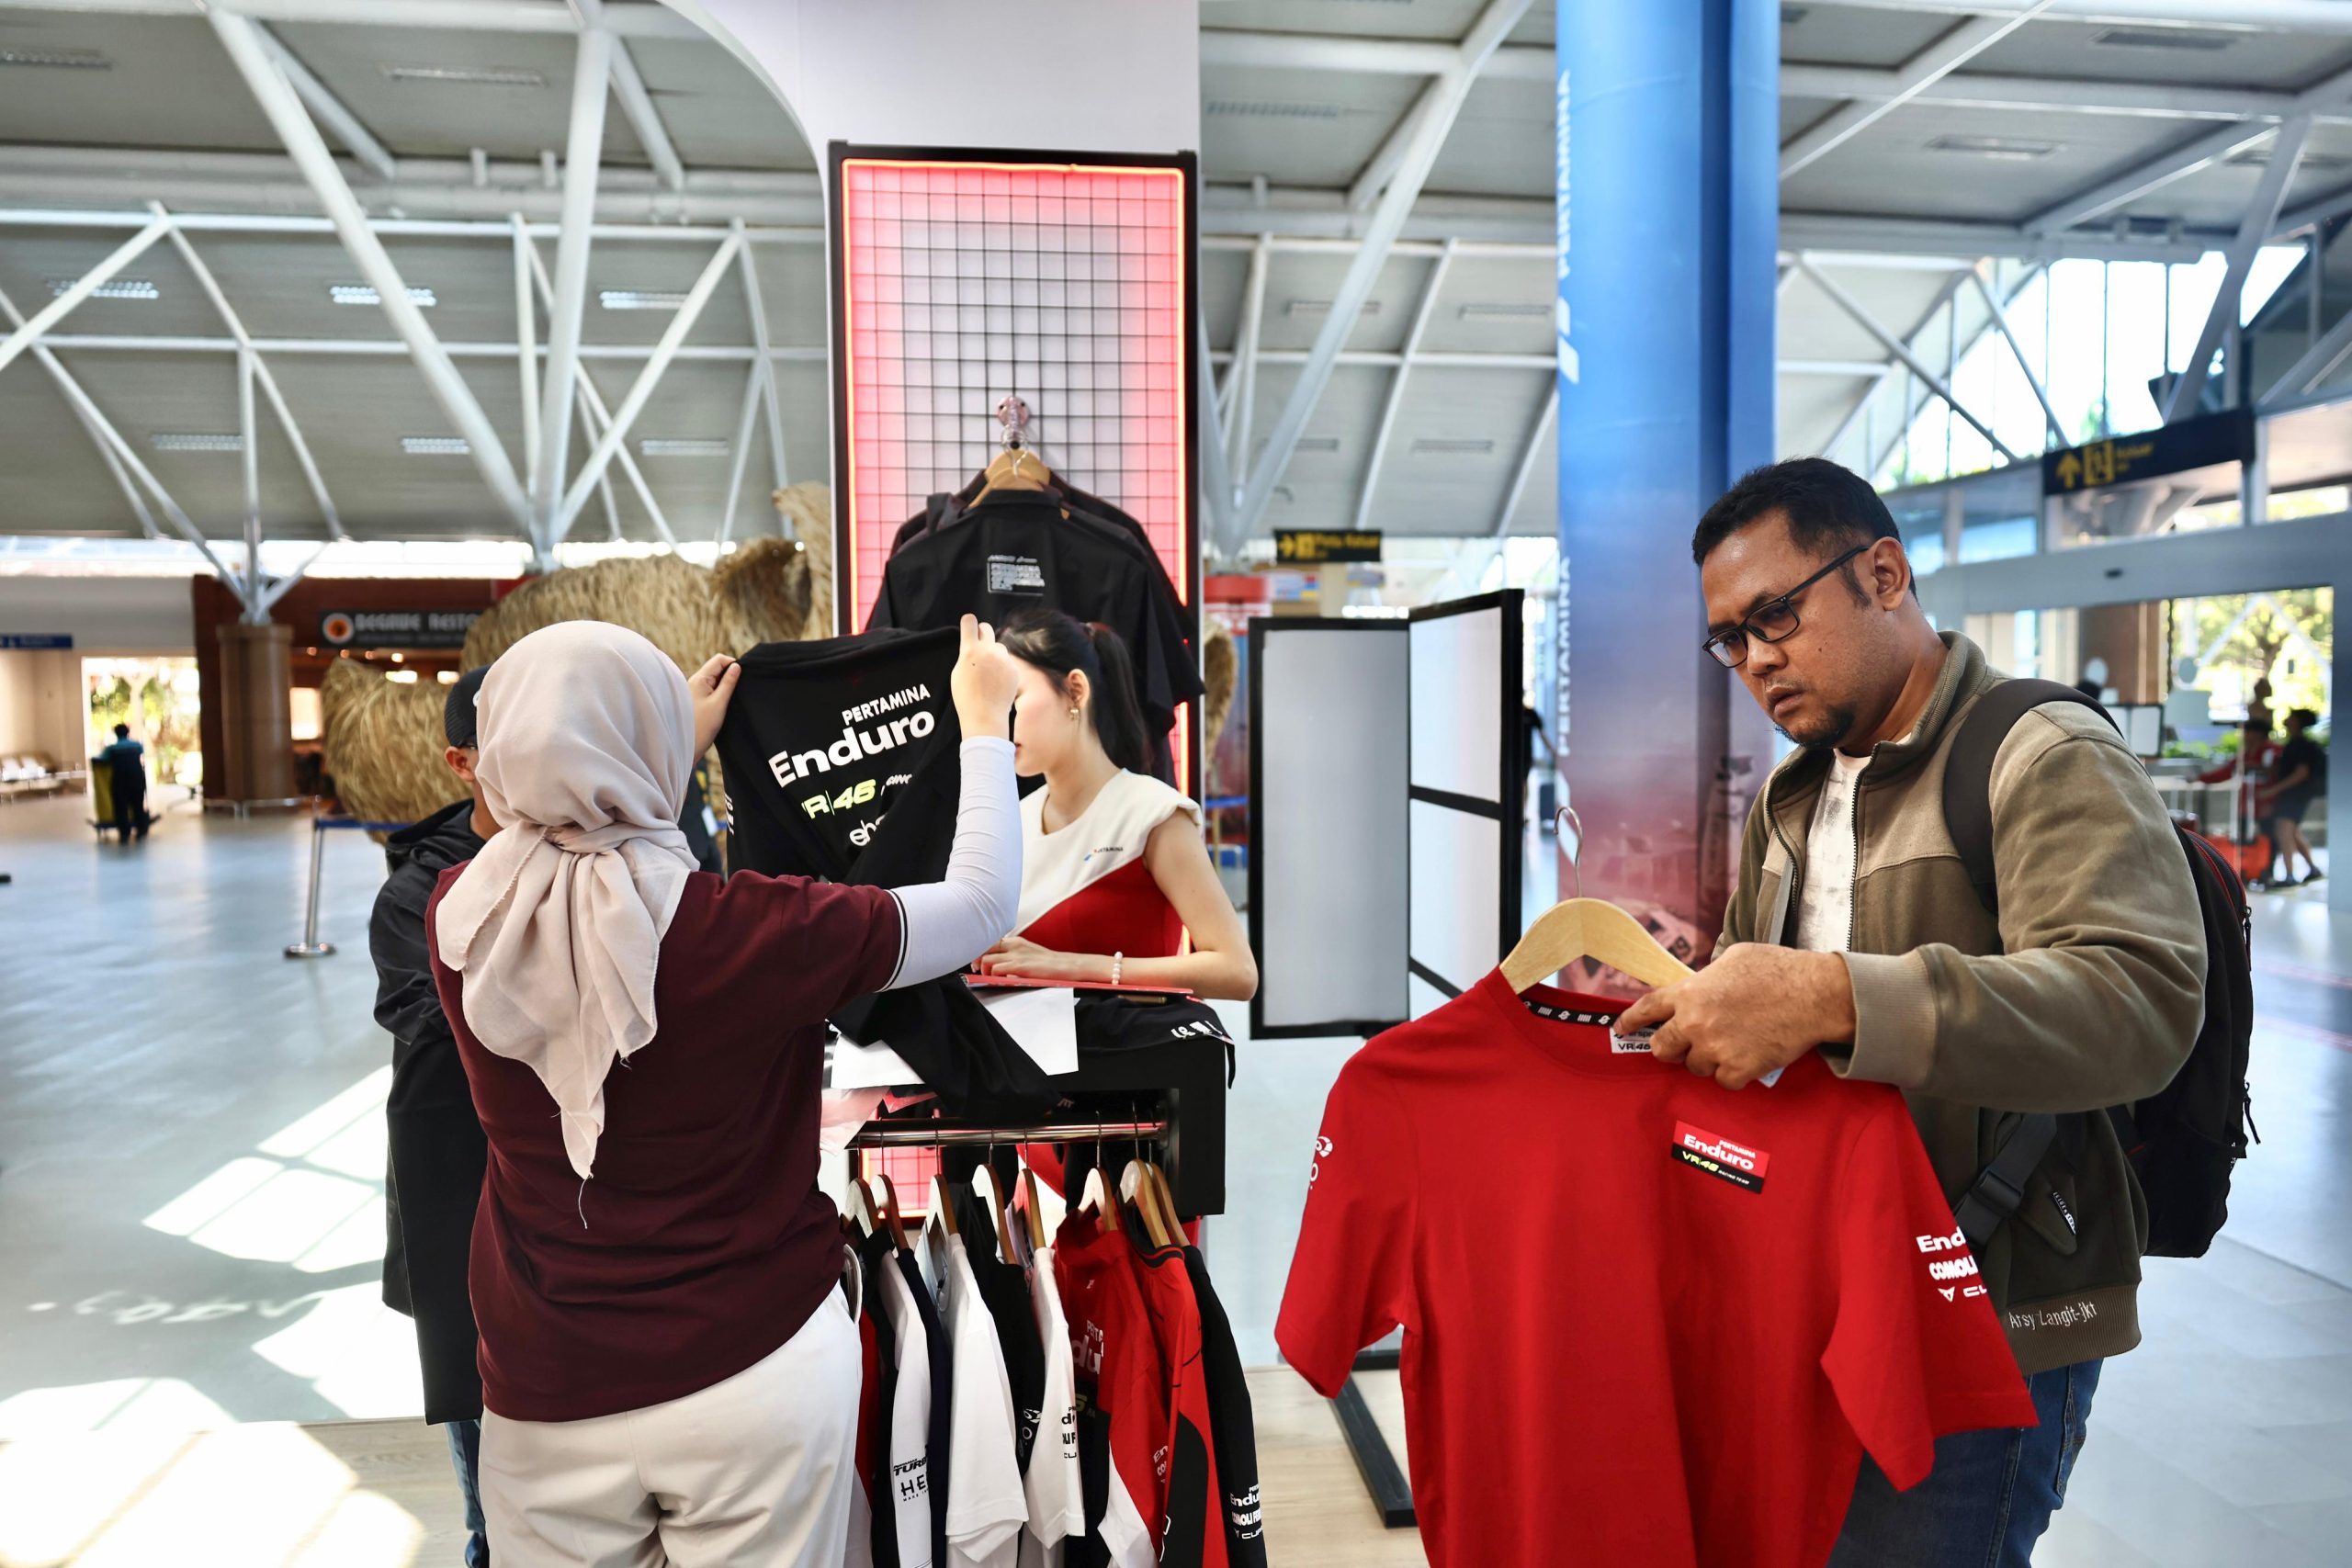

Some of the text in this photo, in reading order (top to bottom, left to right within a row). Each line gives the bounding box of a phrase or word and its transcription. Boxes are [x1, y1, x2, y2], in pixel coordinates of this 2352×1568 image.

[1557, 69, 1570, 280] PERTAMINA
[1559, 557, 1570, 757] PERTAMINA
[842, 683, 931, 726] PERTAMINA
[768, 711, 935, 788] Enduro
[1683, 1134, 1755, 1170] Enduro
[1719, 1140, 1756, 1158] PERTAMINA
[2008, 1312, 2035, 1330] Arsy
